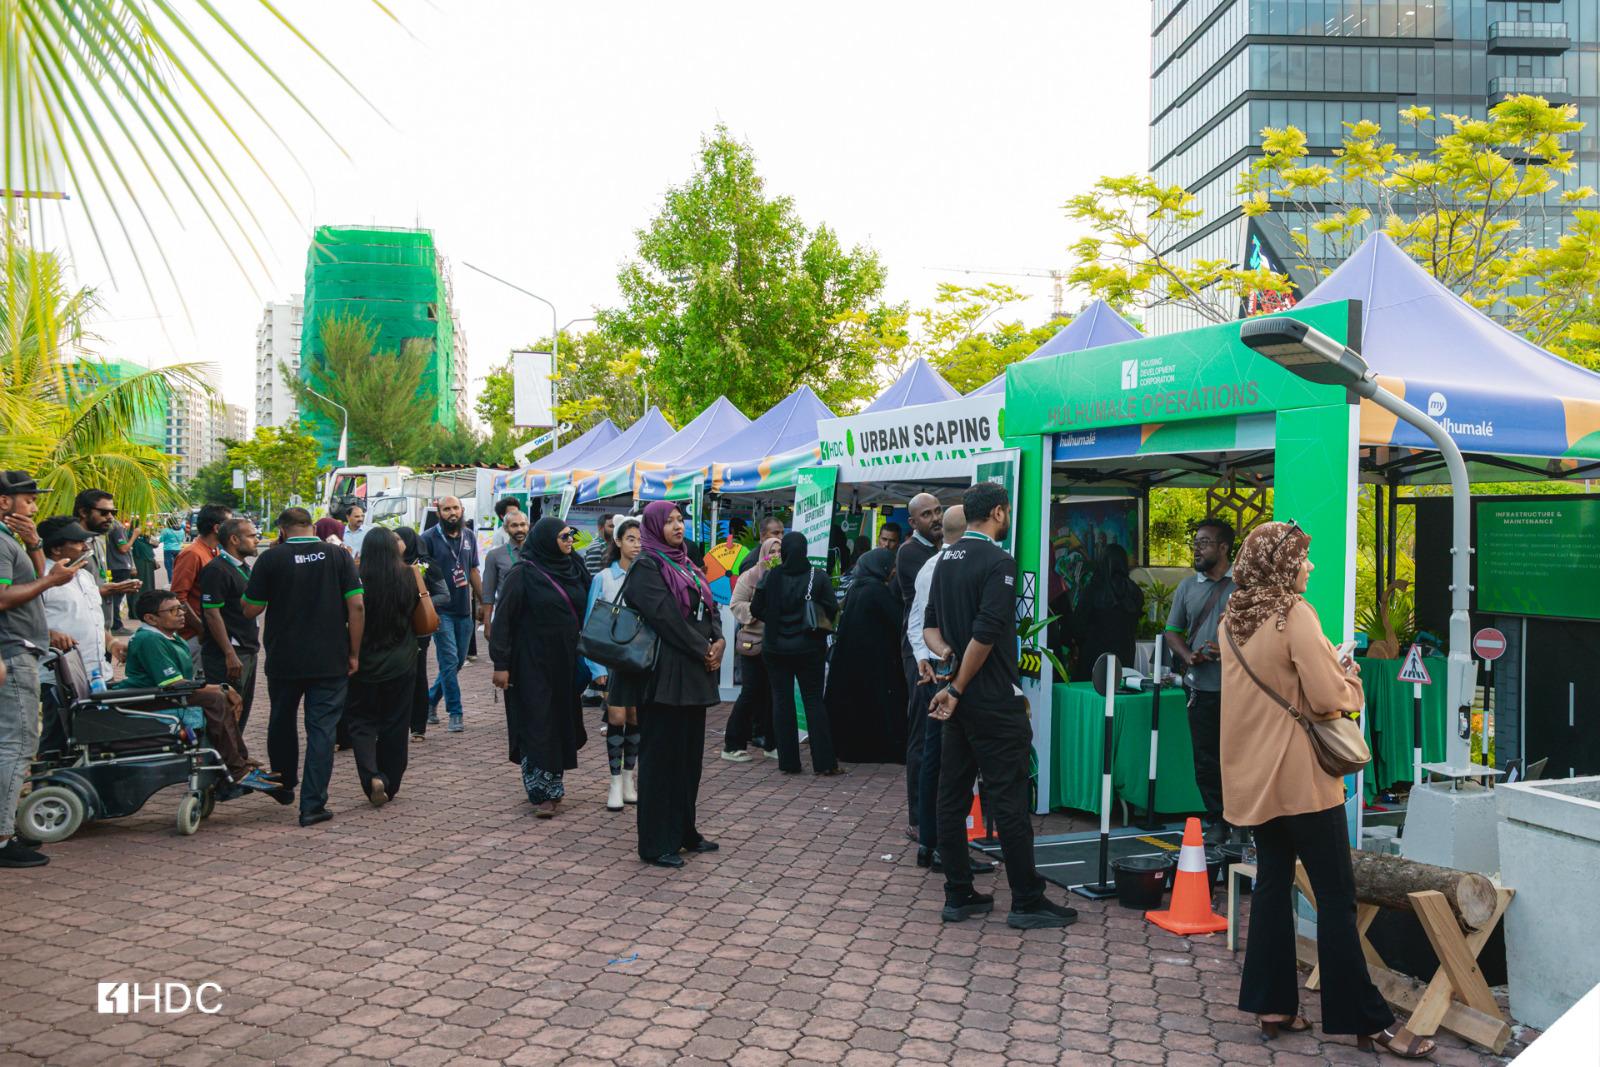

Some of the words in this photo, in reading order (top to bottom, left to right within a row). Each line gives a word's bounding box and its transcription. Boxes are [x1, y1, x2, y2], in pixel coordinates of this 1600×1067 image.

[1140, 357, 1163, 367] HOUSING
[1140, 365, 1176, 377] DEVELOPMENT
[1140, 375, 1175, 386] CORPORATION
[1048, 396, 1137, 427] HULHUMALE
[1141, 381, 1259, 417] OPERATIONS
[1430, 400, 1445, 412] my
[860, 425, 910, 454] URBAN
[914, 416, 991, 448] SCAPING
[829, 441, 844, 458] HDC
[303, 552, 326, 563] HDC
[949, 550, 966, 560] HDC
